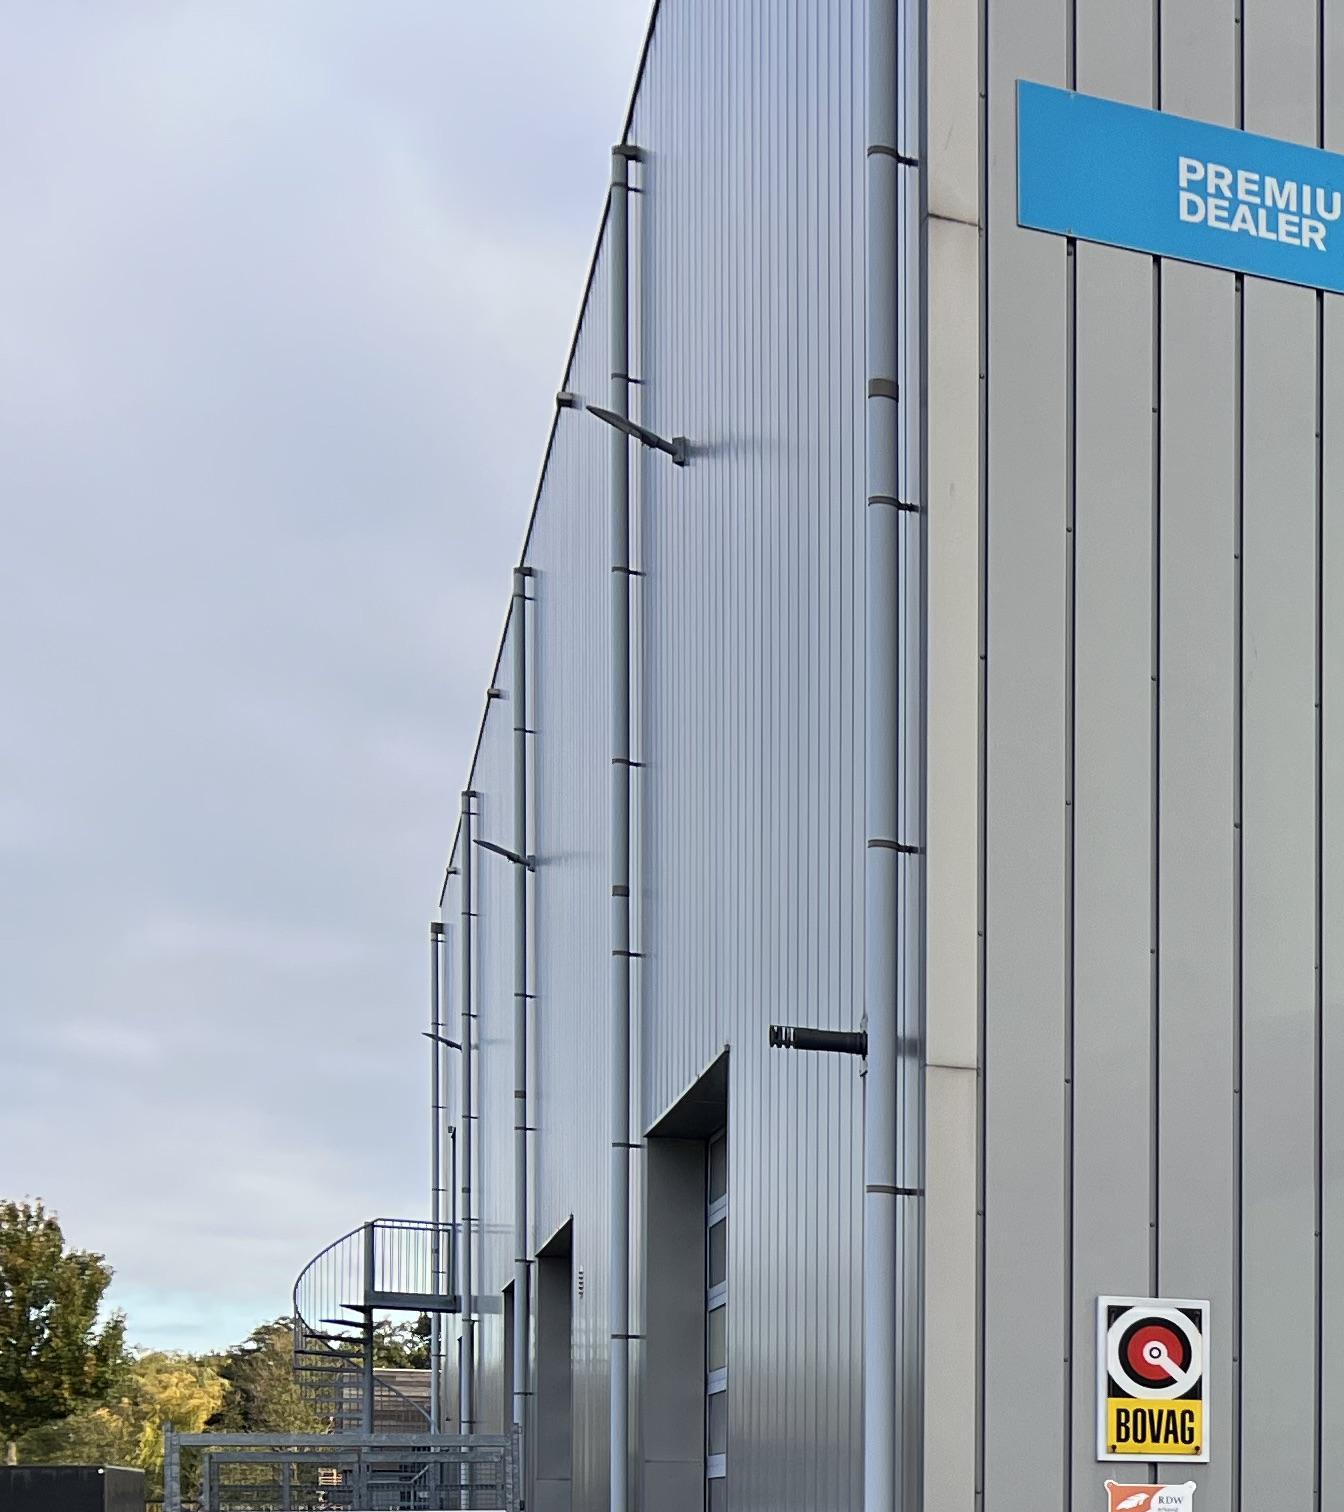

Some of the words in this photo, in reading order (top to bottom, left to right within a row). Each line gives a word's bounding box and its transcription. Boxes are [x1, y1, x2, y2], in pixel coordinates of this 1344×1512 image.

[1177, 190, 1327, 252] DEALER
[1115, 1407, 1195, 1445] BOVAG
[1157, 1495, 1184, 1505] RDW
